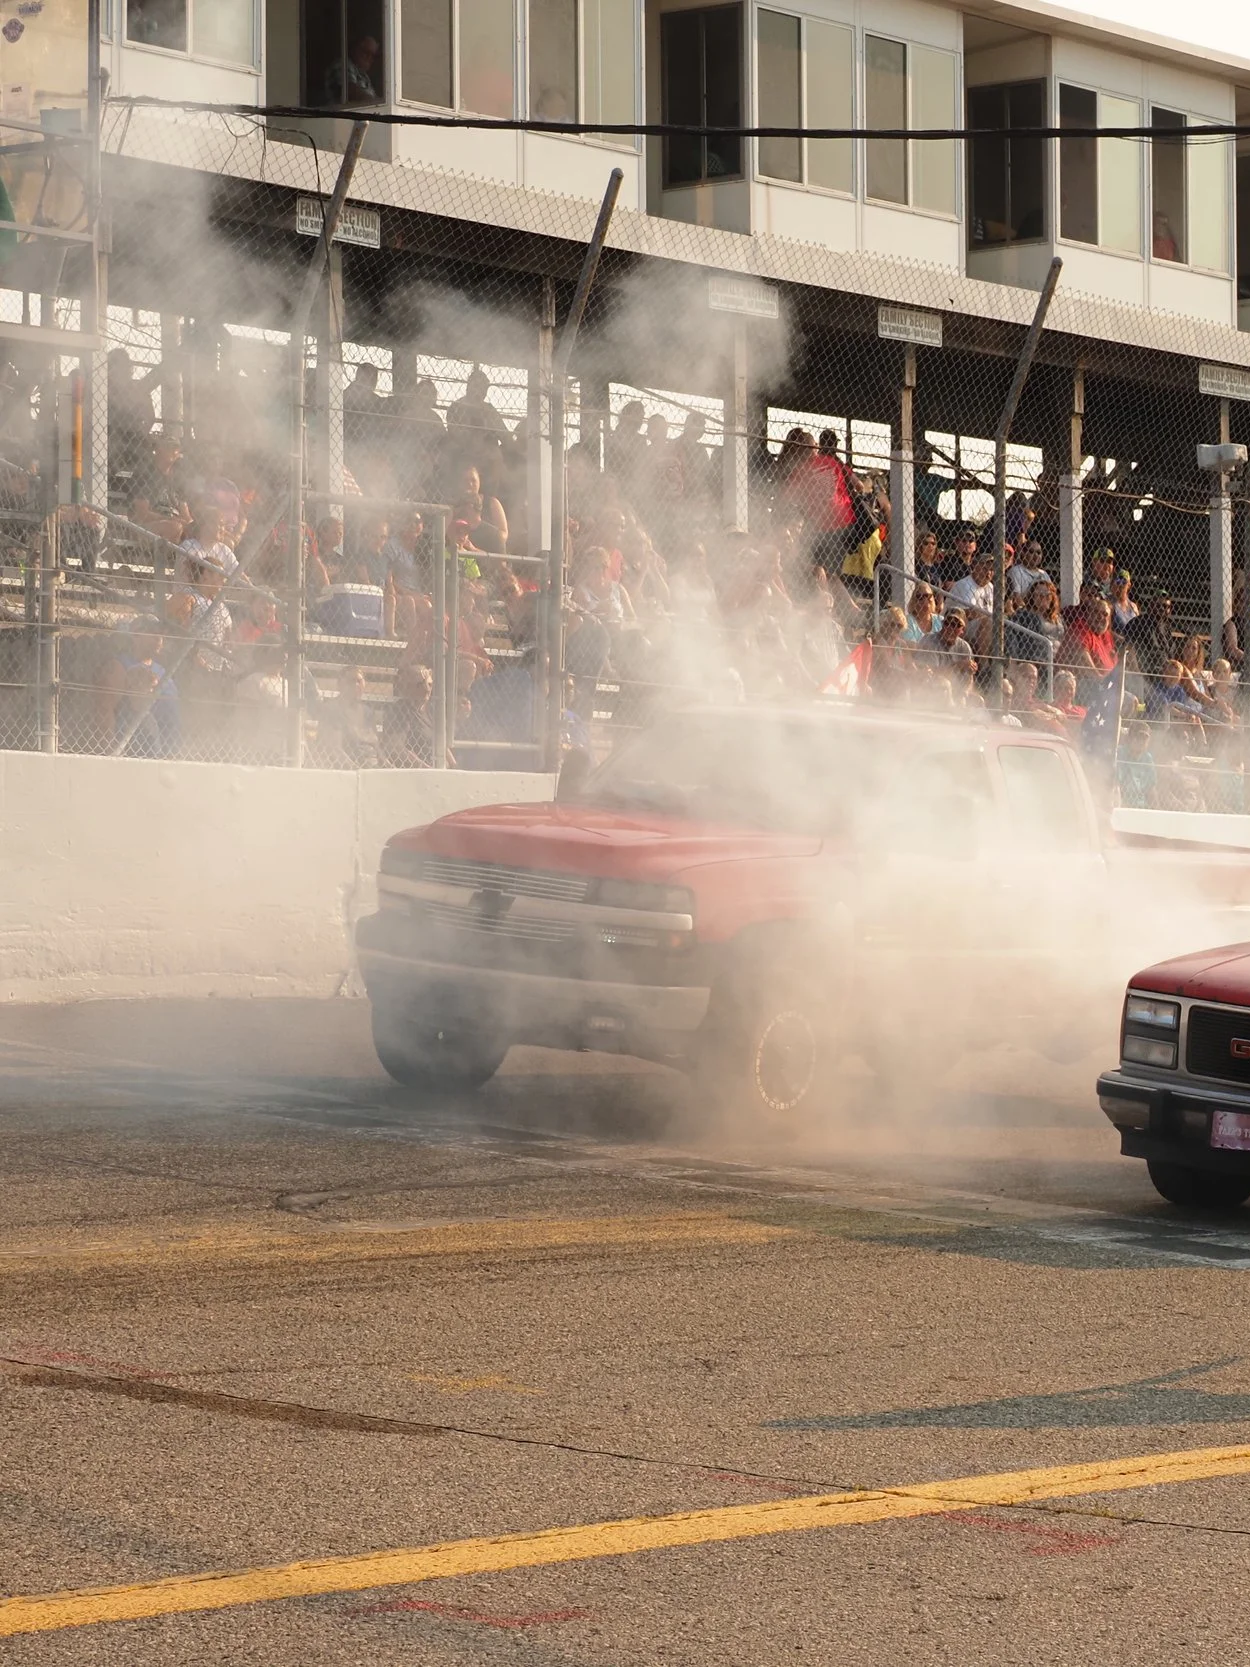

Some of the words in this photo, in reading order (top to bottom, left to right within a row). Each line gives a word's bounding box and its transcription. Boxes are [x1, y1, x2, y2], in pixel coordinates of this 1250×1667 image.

[339, 209, 378, 231] SECTION
[880, 309, 907, 326] FAMILY
[908, 313, 940, 331] SECTION
